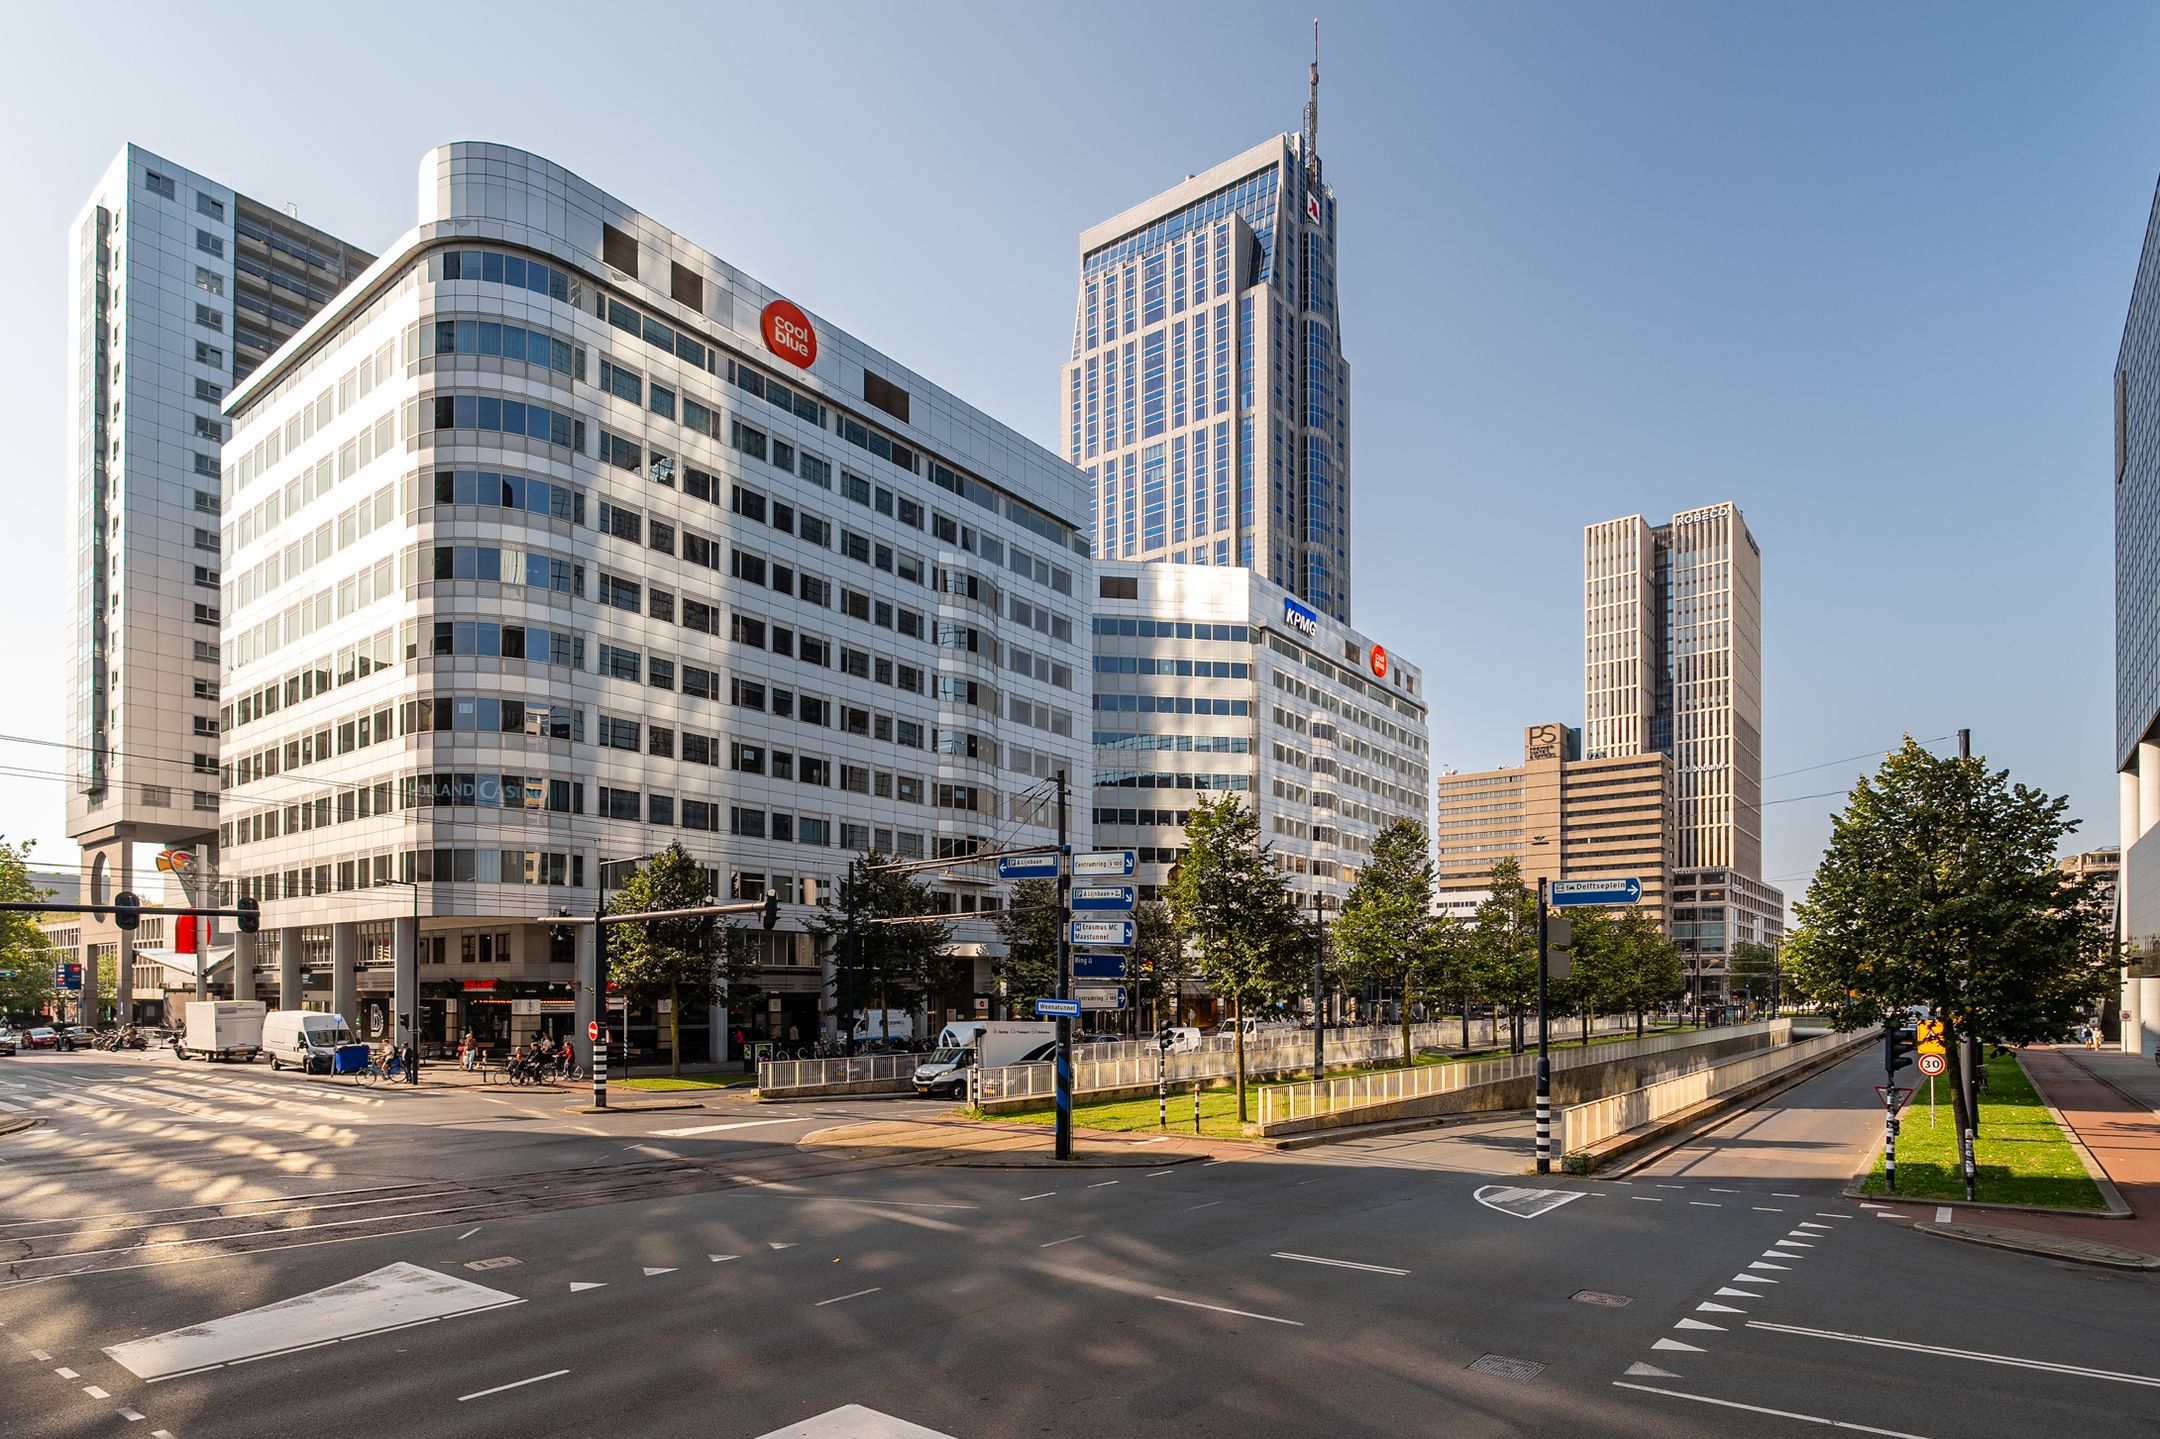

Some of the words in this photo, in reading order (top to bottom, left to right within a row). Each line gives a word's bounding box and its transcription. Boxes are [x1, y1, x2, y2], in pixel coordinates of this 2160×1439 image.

[775, 316, 808, 343] cool
[775, 326, 808, 357] blue
[1677, 507, 1728, 526] ROBECO
[1286, 608, 1317, 637] KPMG
[1530, 725, 1556, 746] PS
[408, 782, 473, 803] HOLLAND
[1576, 881, 1626, 891] Delftseplein
[1088, 890, 1109, 898] Lijnbaan
[1082, 923, 1107, 931] Erasmus
[1108, 923, 1118, 931] MC
[1075, 957, 1087, 965] Ring
[1039, 1003, 1076, 1011] Weenatunnel
[1925, 1060, 1940, 1068] 30
